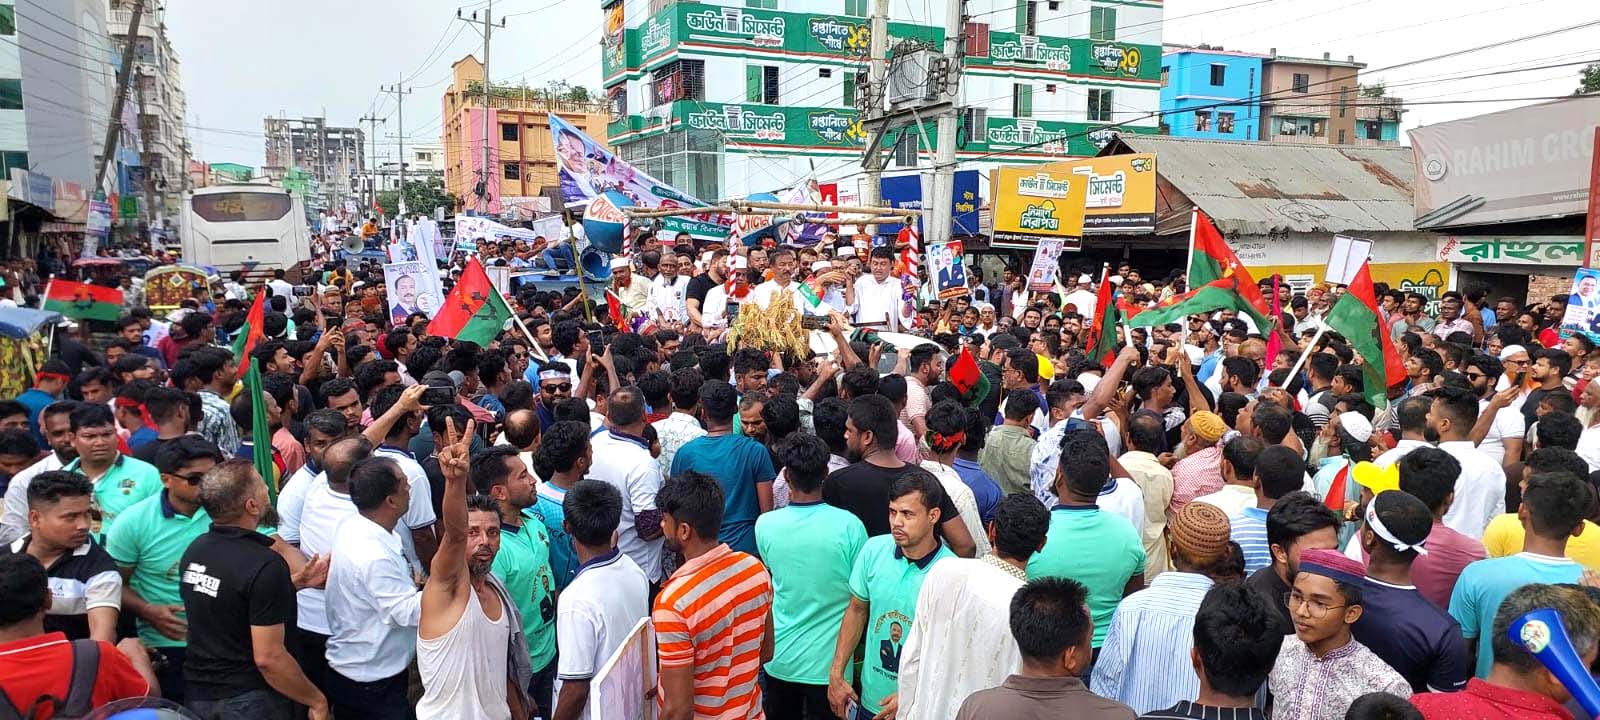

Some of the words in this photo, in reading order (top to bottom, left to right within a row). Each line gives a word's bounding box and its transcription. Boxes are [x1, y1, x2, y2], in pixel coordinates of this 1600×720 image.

[687, 11, 725, 31] ক্রাউন
[741, 15, 784, 36] সিমেন্ট
[811, 20, 849, 35] রপ্তানিতে
[991, 42, 1023, 59] ক্রাউন
[1036, 44, 1070, 62] সিমেন্ট
[689, 110, 726, 129] ক্রাউন
[742, 112, 784, 131] সিমেন্ট
[811, 114, 848, 127] রপ্তানিতে
[1454, 138, 1536, 177] RAHIM
[1089, 174, 1123, 196] সিমেন্ট
[1459, 237, 1585, 263] রাহুল
